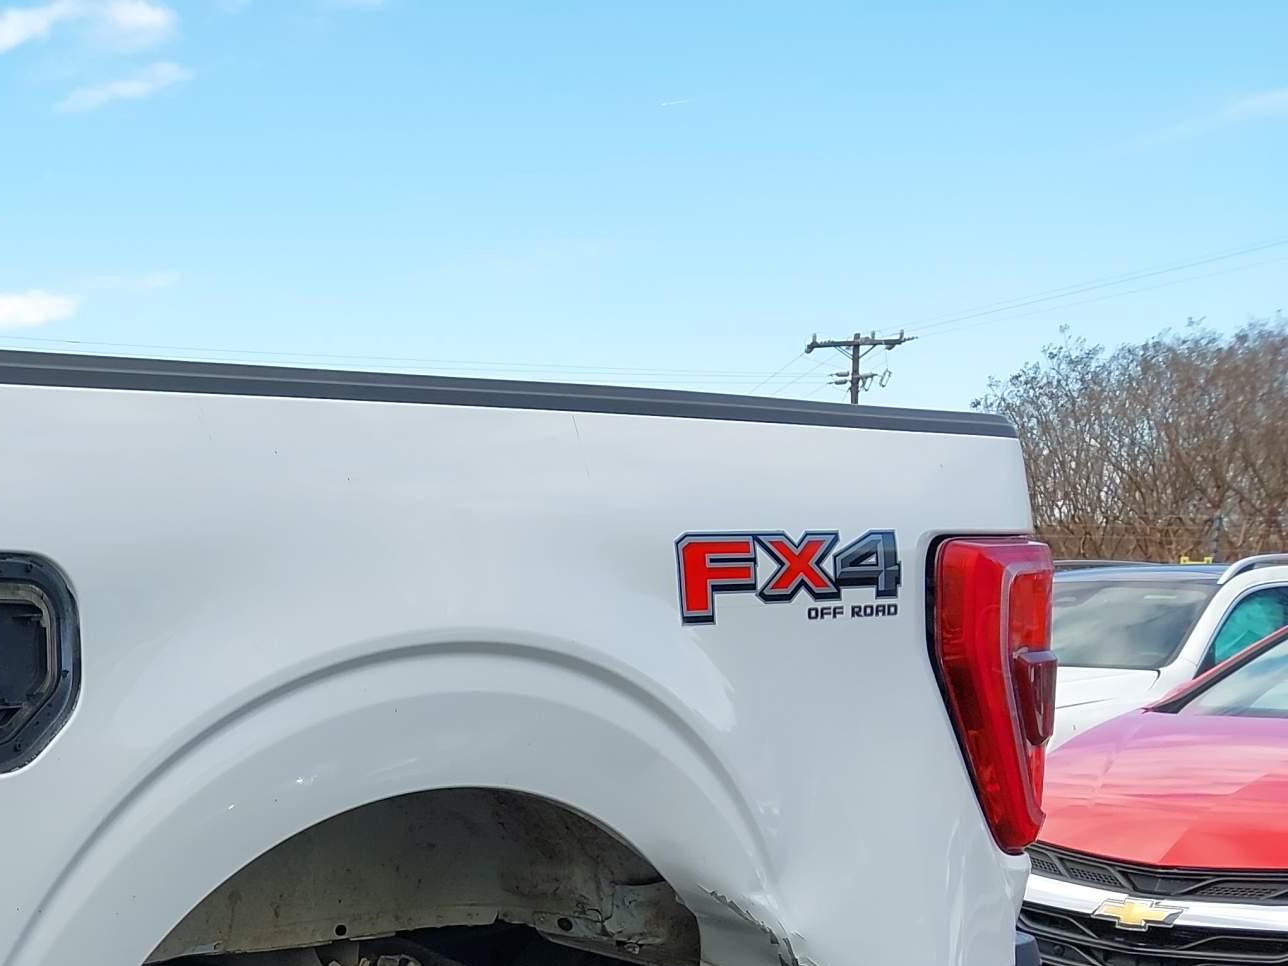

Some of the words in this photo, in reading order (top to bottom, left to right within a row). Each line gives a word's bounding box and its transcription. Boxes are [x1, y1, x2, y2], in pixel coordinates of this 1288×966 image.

[675, 529, 901, 625] FX4
[807, 605, 844, 620] OFF
[851, 603, 898, 618] ROAD
